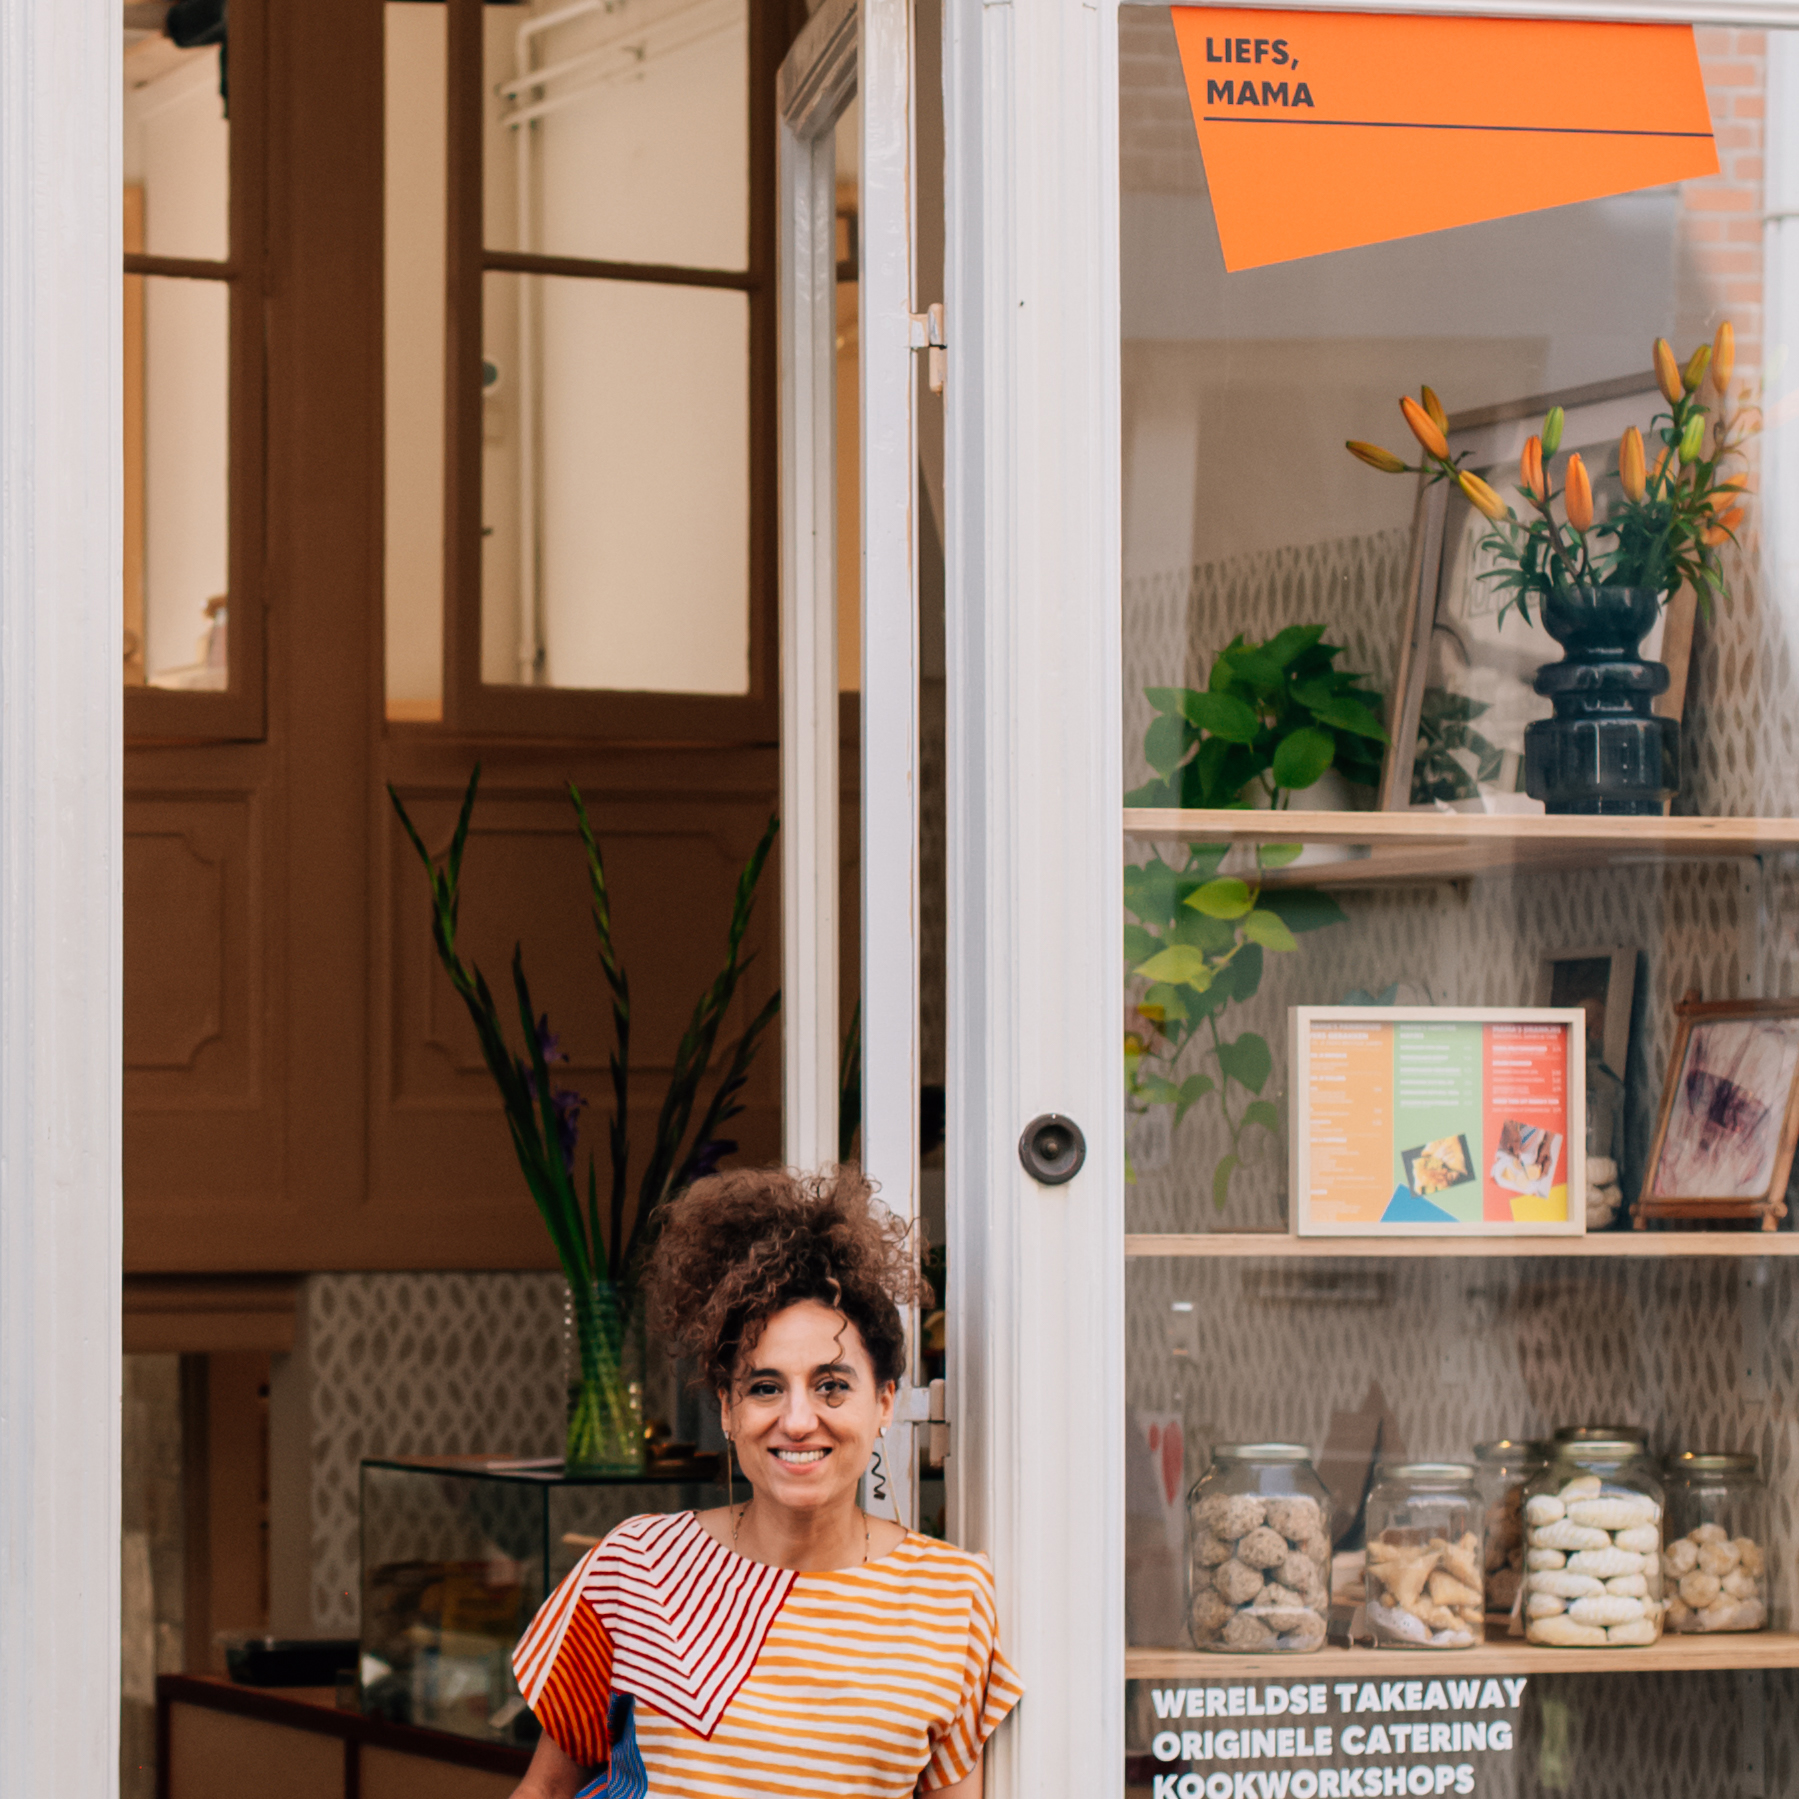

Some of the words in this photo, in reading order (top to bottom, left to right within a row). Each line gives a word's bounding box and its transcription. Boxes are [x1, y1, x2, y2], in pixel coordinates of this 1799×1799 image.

[1205, 37, 1300, 70] LIEFS,
[1206, 78, 1315, 108] MAMA
[1153, 1683, 1327, 1718] WERELDSE
[1335, 1678, 1527, 1715] TAKEAWAY
[1152, 1726, 1332, 1761] ORIGINELE
[1341, 1720, 1513, 1755] CATERING
